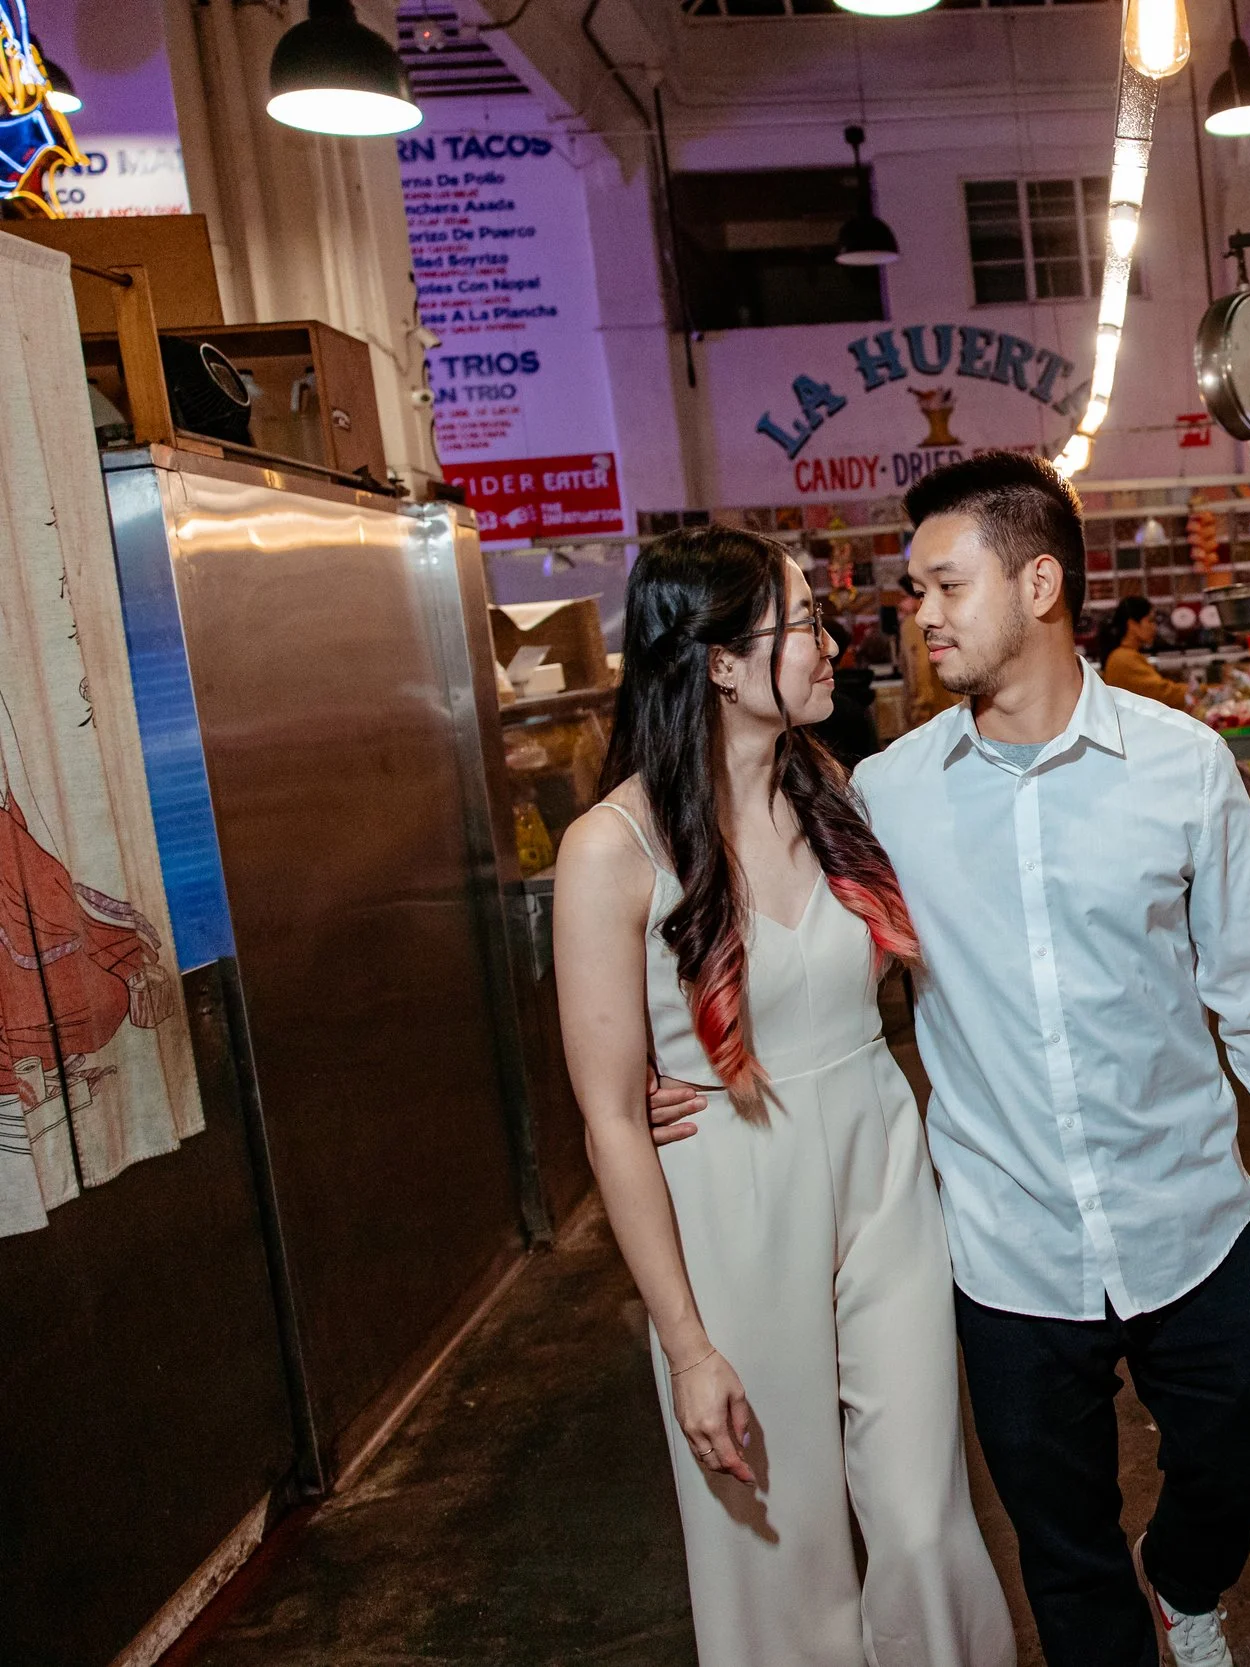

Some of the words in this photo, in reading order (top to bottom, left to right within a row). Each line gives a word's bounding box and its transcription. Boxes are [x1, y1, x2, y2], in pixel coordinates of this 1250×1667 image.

[443, 135, 553, 160] TACOS
[440, 350, 540, 378] TRIOS
[464, 383, 517, 401] TRIO
[756, 373, 847, 460] LA
[794, 454, 880, 493] CANDY
